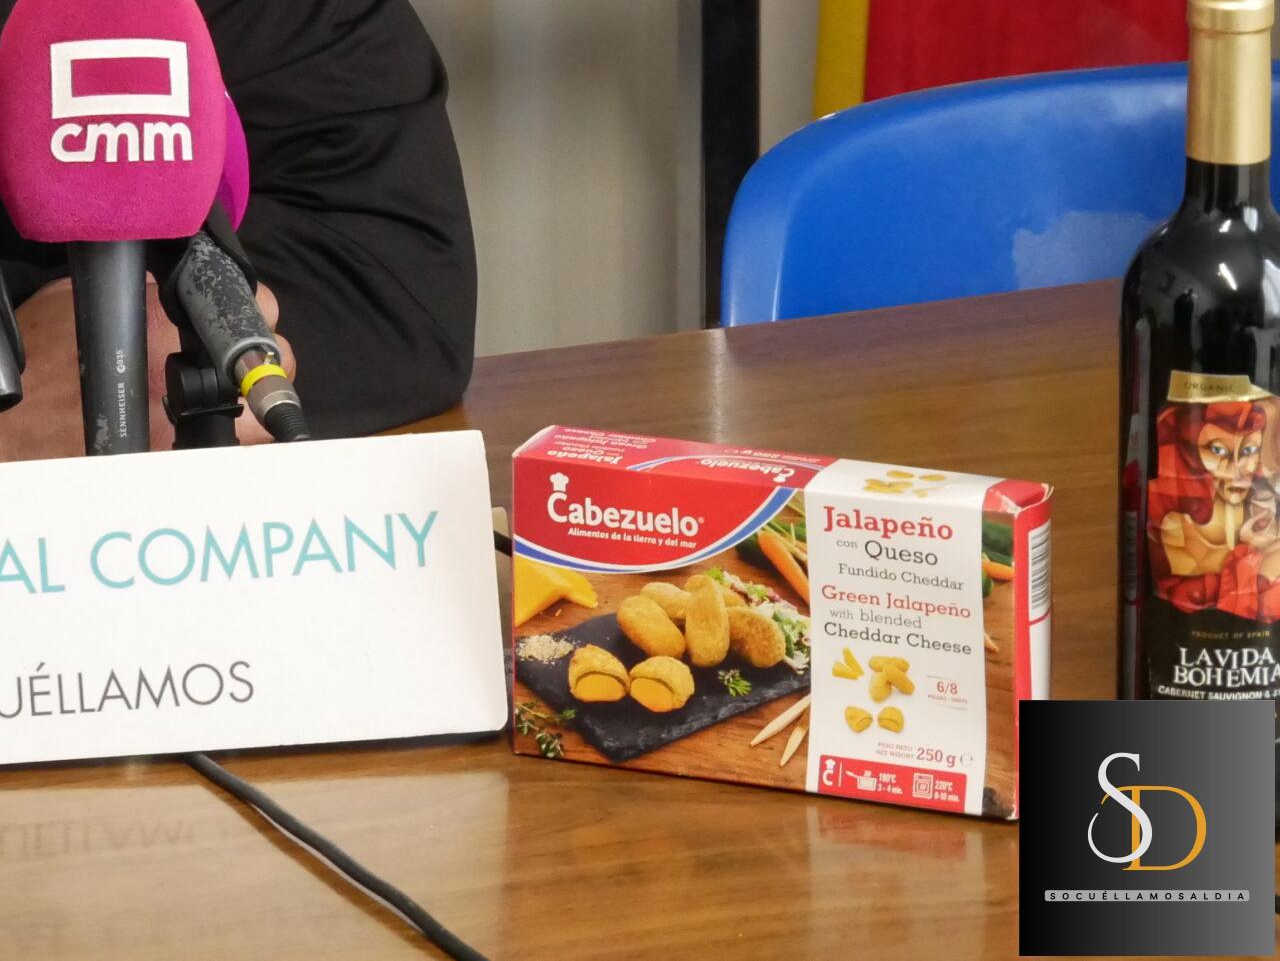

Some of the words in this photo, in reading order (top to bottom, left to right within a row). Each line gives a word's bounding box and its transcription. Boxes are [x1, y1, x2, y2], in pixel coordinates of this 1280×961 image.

[50, 121, 194, 164] cmm
[117, 382, 127, 438] SENNHEISER
[547, 491, 699, 537] Cabezuelo
[823, 505, 953, 540] Jalapeño
[90, 510, 440, 592] COMPANY
[567, 527, 609, 539] Alimentos
[611, 531, 621, 541] de
[623, 532, 632, 542] la
[633, 534, 657, 545] tierra
[657, 538, 663, 547] y
[665, 537, 678, 547] del
[680, 540, 697, 549] mar
[836, 539, 858, 549] con
[864, 540, 938, 566] Queso
[838, 562, 897, 581] Fundido
[901, 570, 964, 591] Cheddar
[821, 584, 881, 606] Green
[886, 591, 971, 619] Jalapeño
[829, 607, 854, 620] with
[860, 608, 922, 629] blended
[824, 621, 901, 645] Cheddar
[906, 632, 972, 655] Cheese
[936, 680, 958, 695] 6/8
[1173, 663, 1280, 688] BOHEMIA
[1158, 685, 1206, 700] CABERNET
[916, 747, 943, 763] 250
[946, 755, 956, 768] g
